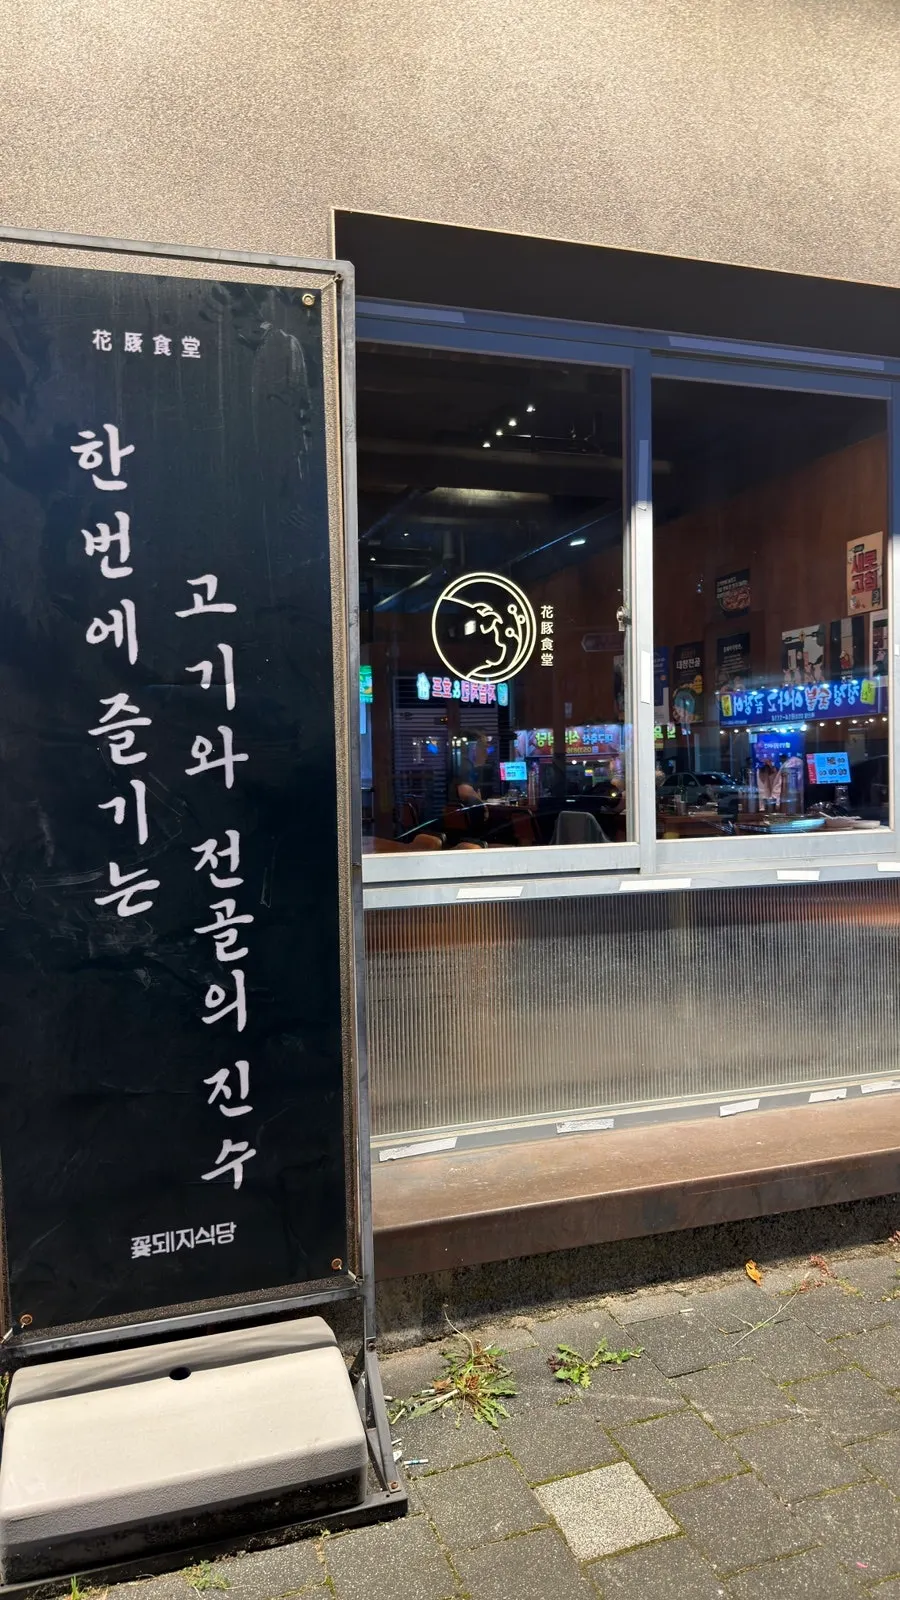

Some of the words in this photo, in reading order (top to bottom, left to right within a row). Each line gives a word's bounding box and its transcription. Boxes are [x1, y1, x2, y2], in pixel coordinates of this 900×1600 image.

[91, 328, 201, 359] 花豚食堂
[70, 423, 139, 665] 한번에
[174, 574, 249, 789] 고기와
[539, 604, 555, 667] 花豚食堂
[87, 692, 161, 917] 즐기는
[191, 829, 254, 1032] 전골의
[201, 1060, 257, 1190] 진수
[130, 1221, 237, 1259] 꽃돼지식당
